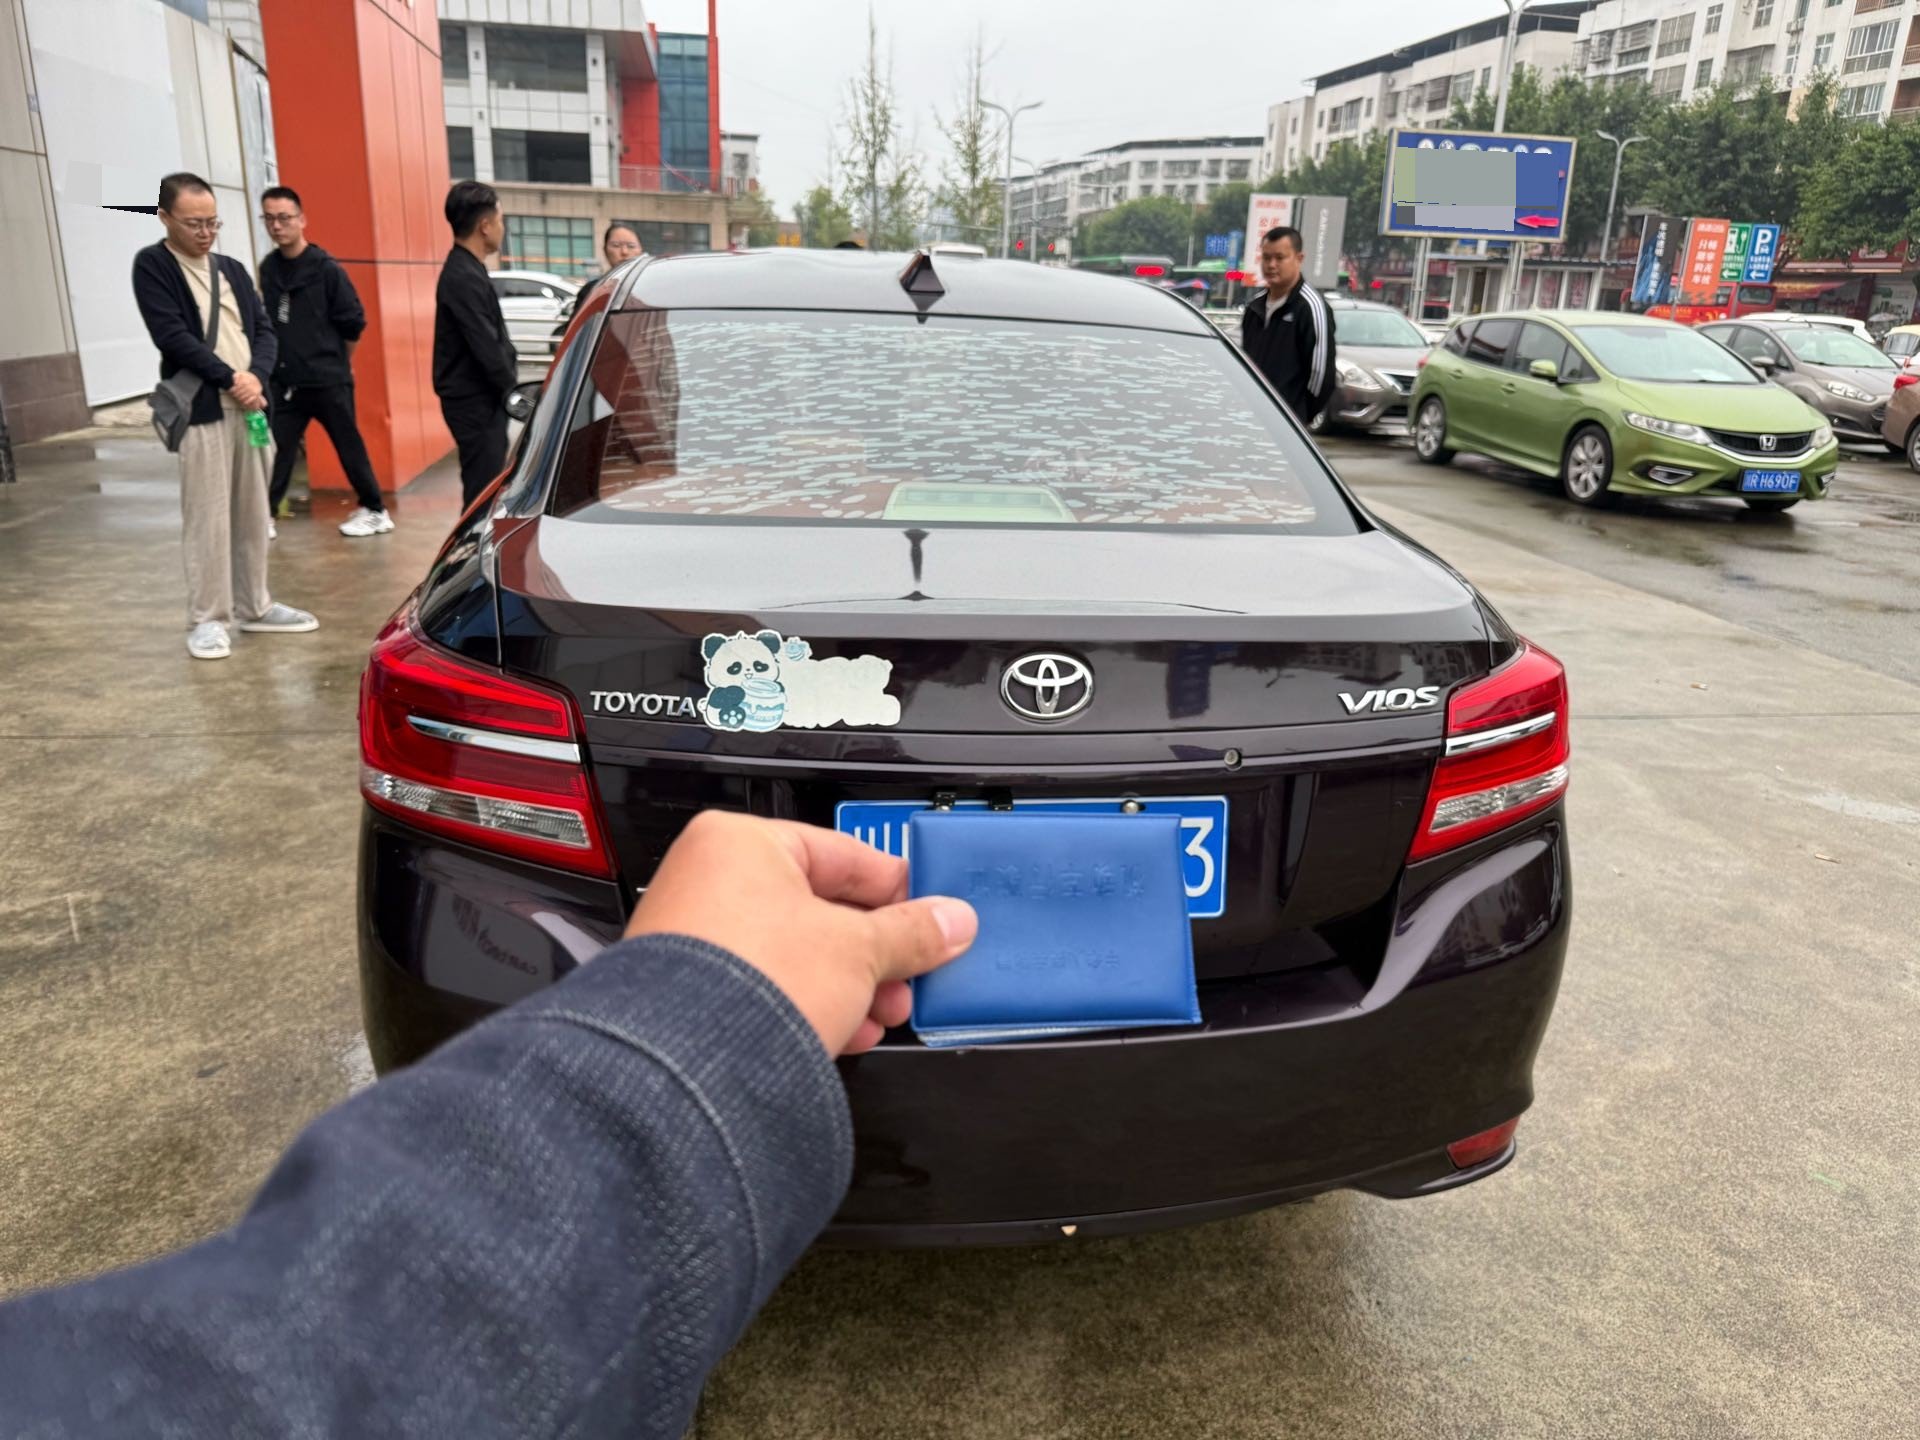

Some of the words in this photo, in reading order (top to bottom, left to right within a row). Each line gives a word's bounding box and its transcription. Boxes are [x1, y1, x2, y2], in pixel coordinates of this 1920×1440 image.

[1754, 229, 1772, 255] P
[590, 690, 697, 718] TOYOTA
[1338, 686, 1440, 714] VIOS
